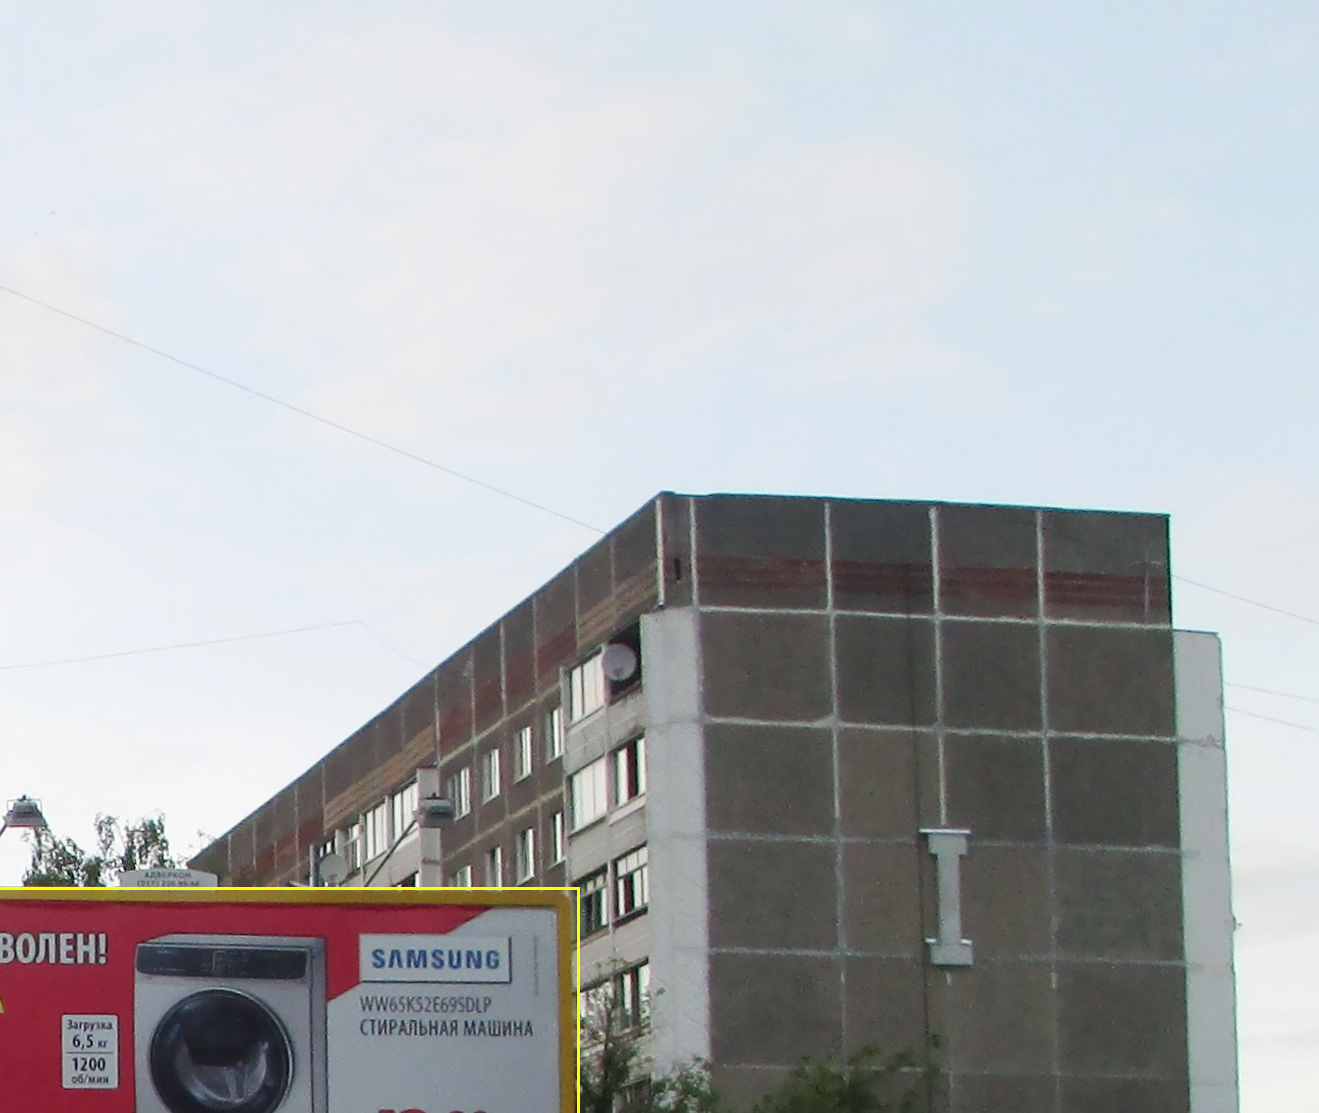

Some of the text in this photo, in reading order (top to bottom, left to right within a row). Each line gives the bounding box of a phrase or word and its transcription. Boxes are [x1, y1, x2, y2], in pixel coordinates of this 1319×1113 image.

[371, 949, 500, 969] SAMSUNG
[67, 1019, 113, 1032] Загрузка
[360, 1018, 534, 1037] СТИРАЛЬНАЯ МАШИНА
[72, 1034, 108, 1050] 6,5 кг
[72, 1057, 106, 1072] 1200
[71, 1073, 109, 1084] об/мин
